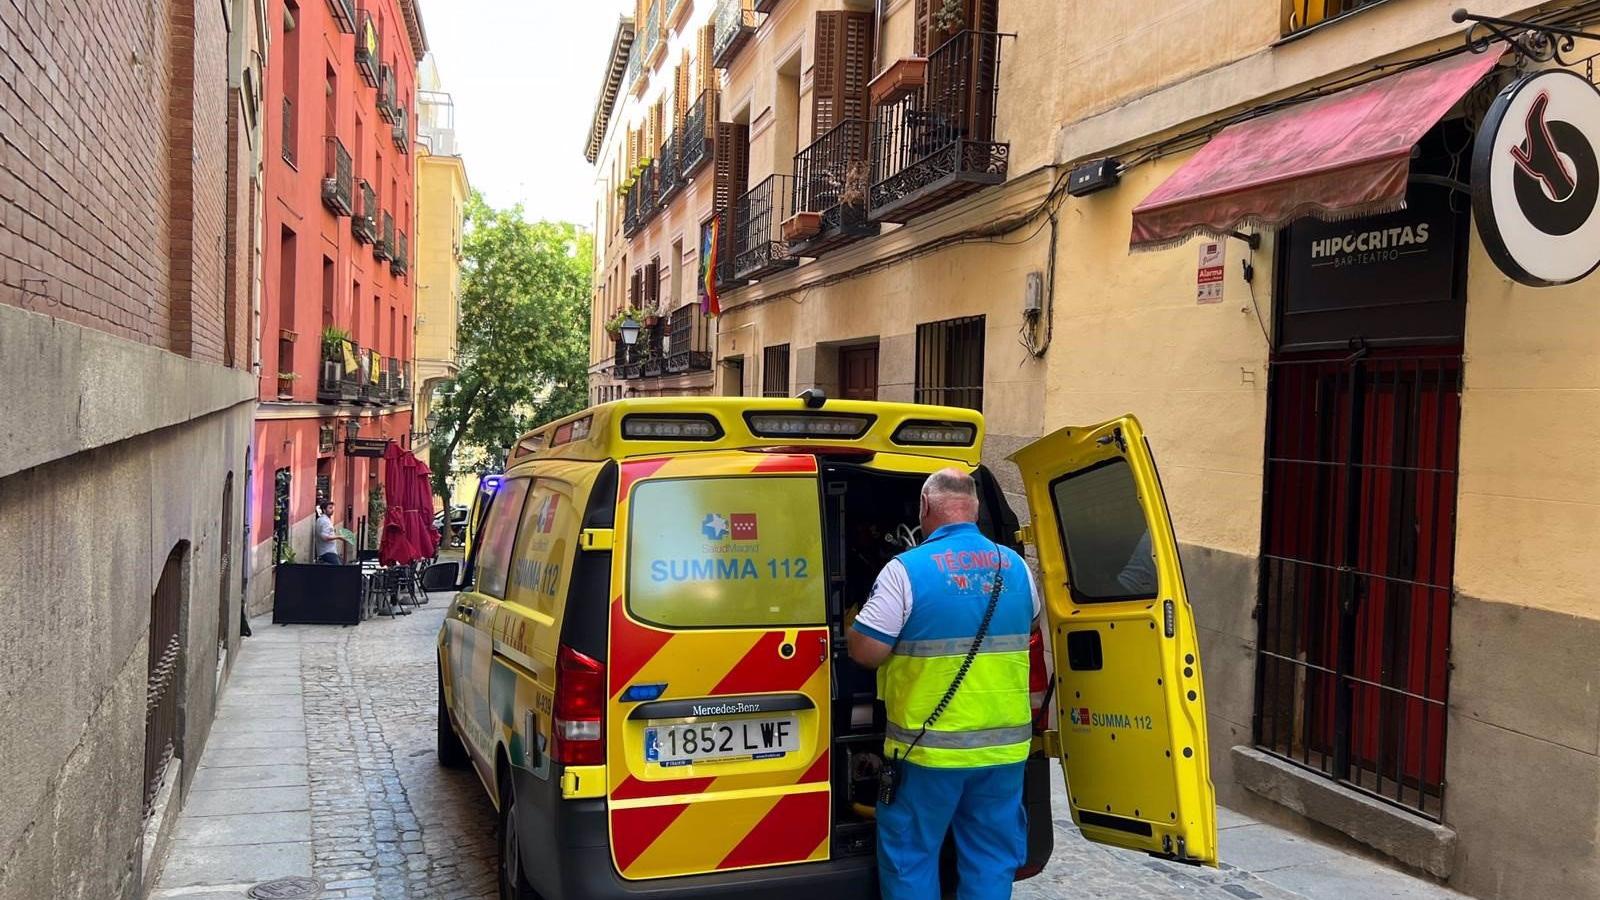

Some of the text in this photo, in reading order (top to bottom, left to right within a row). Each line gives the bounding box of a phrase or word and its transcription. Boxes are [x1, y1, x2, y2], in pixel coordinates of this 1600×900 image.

[1334, 249, 1399, 268] BAR-TEATRO
[542, 563, 560, 597] 112
[651, 557, 809, 582] SUMMA 112
[692, 702, 760, 716] Mercedes-Benz
[1091, 713, 1153, 730] SUMMA 112
[668, 721, 791, 756] 1852 LWF
